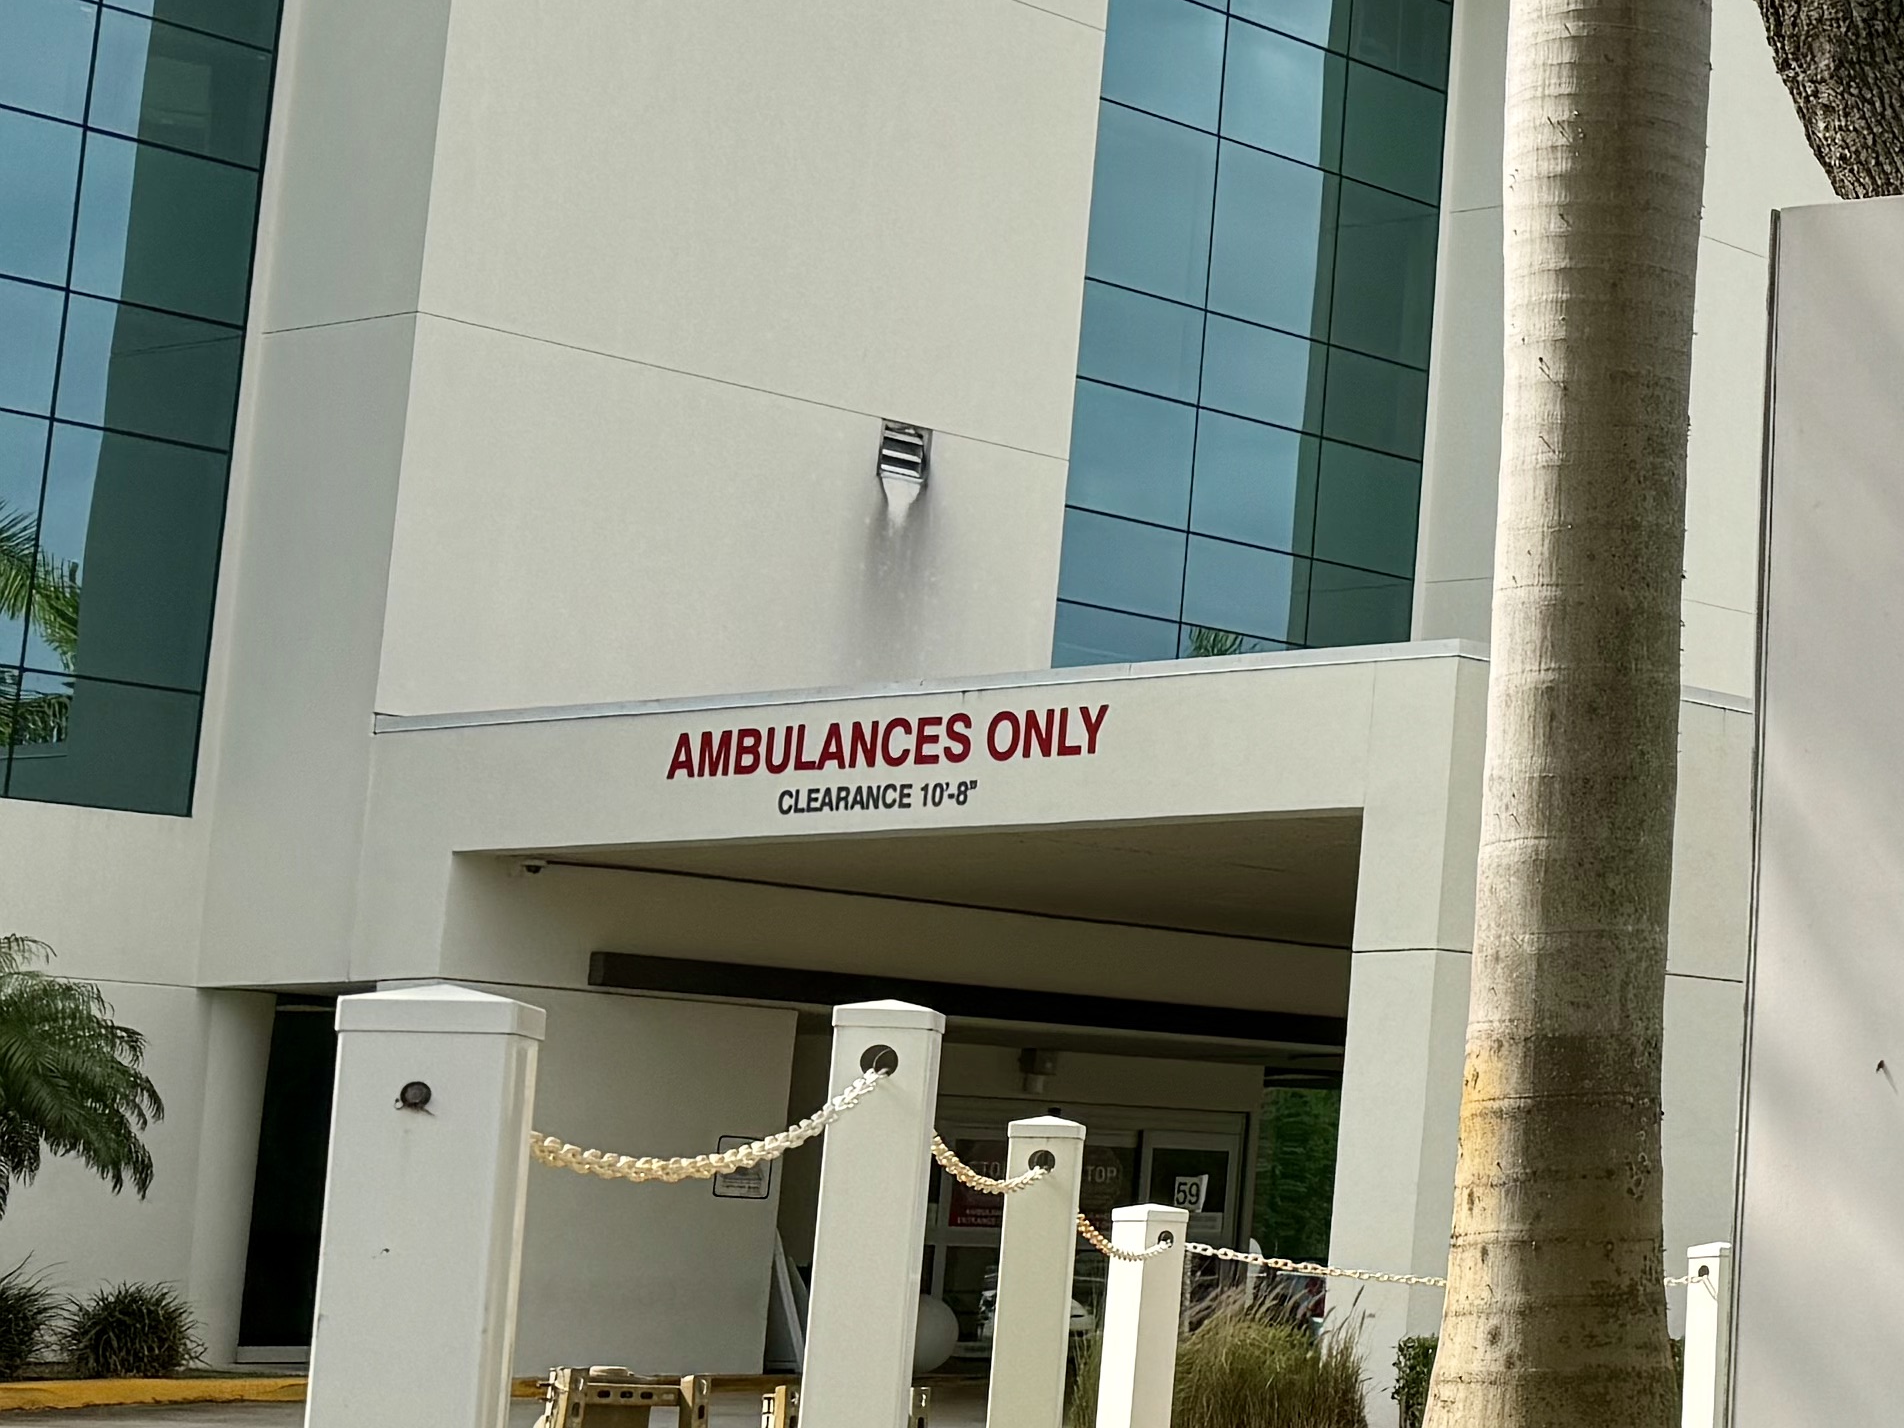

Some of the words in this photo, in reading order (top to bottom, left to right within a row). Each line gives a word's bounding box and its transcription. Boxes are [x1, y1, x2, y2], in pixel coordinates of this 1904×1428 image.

[666, 712, 972, 780] AMBULANCES
[986, 704, 1110, 762] ONLY
[777, 782, 913, 816] CLEARANCE
[1175, 1181, 1200, 1206] 59
